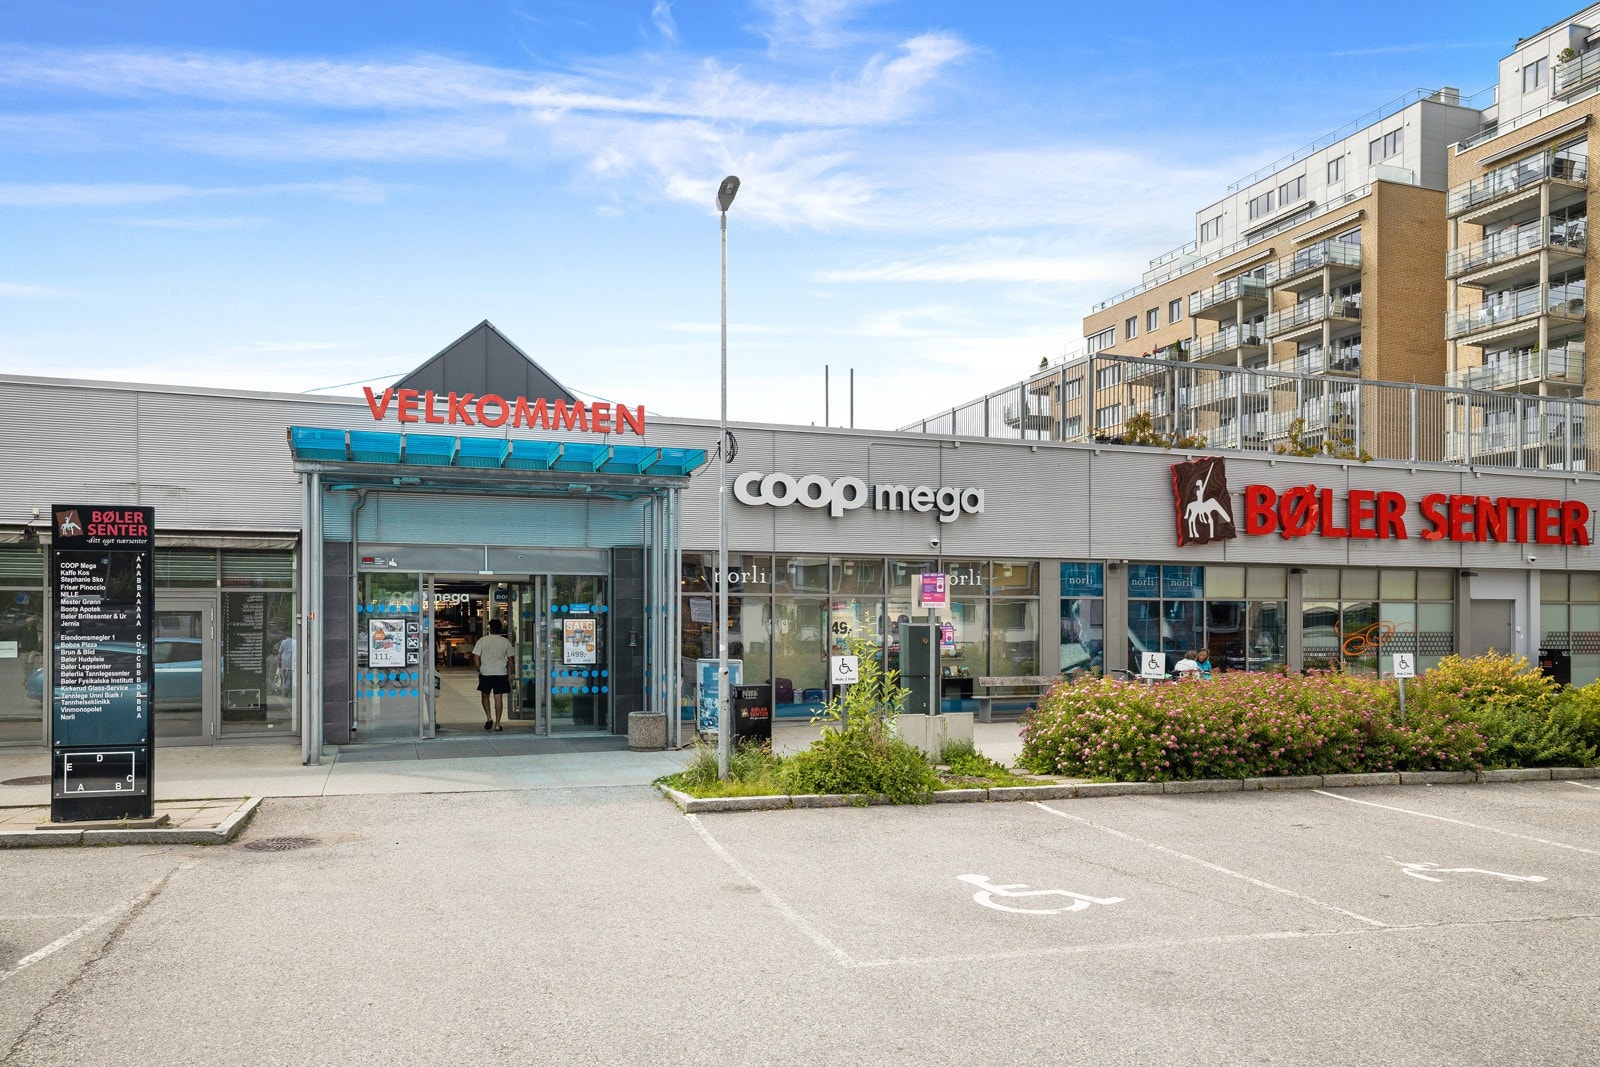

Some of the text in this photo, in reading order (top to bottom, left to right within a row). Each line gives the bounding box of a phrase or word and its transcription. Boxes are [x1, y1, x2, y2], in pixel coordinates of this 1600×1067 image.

[363, 386, 645, 435] VELKOMMEN
[733, 470, 985, 523] coop mega
[92, 510, 143, 523] BØLER
[1245, 483, 1590, 546] BØLER SENTER
[88, 524, 148, 536] SENTER
[102, 538, 115, 546] eget
[950, 569, 981, 585] orli
[1070, 576, 1093, 585] norli
[1131, 577, 1154, 586] norli
[1171, 578, 1193, 587] norli
[566, 622, 593, 630] SALG
